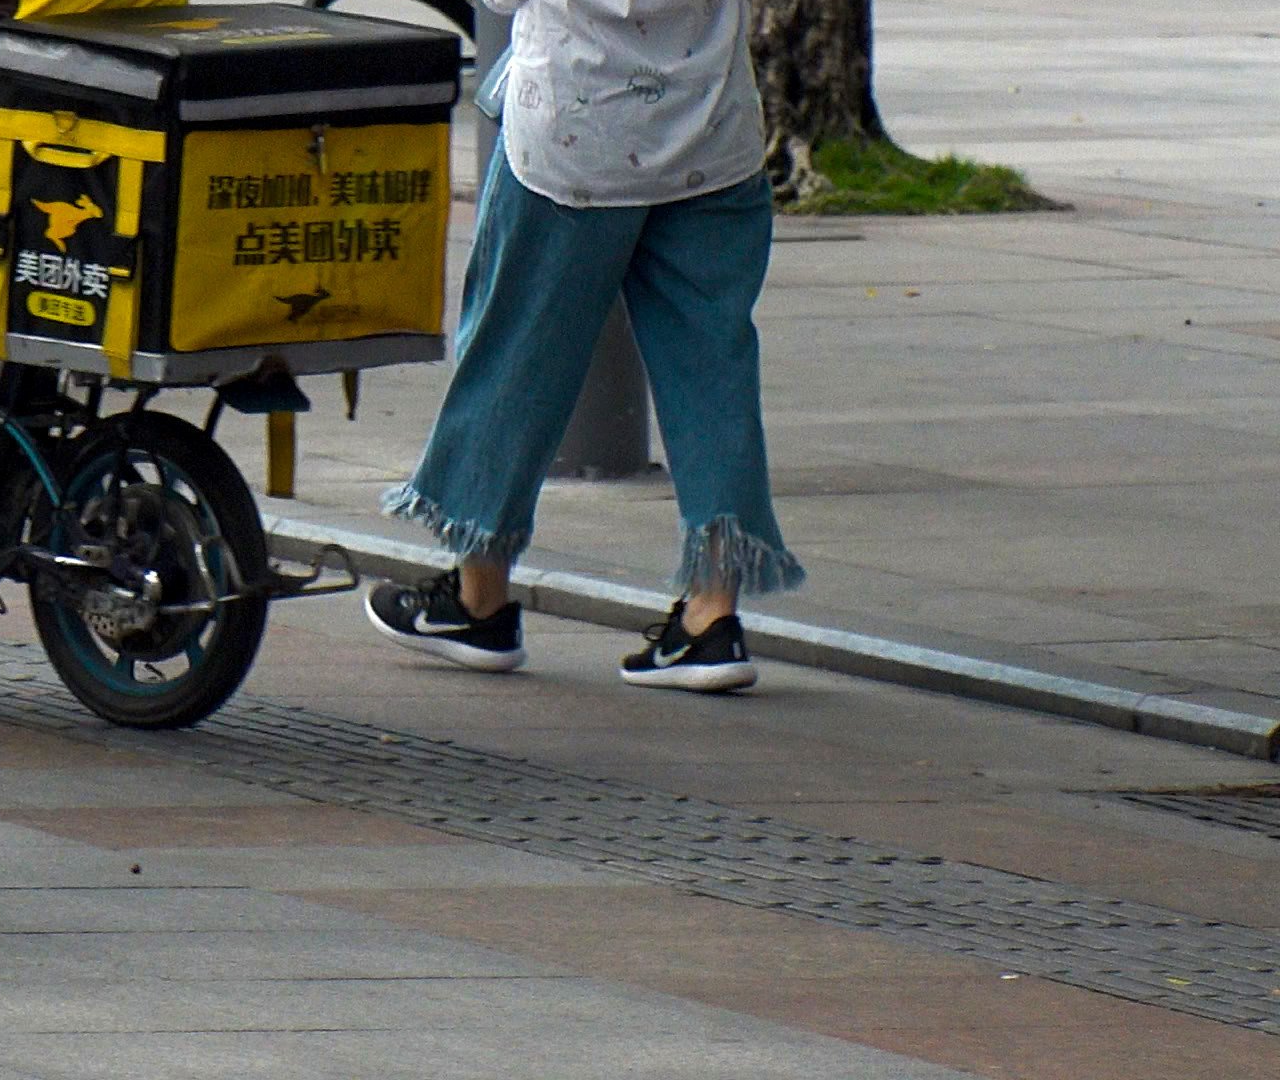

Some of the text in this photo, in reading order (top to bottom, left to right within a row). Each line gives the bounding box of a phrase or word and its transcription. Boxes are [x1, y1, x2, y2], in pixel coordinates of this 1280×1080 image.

[232, 219, 403, 266] 点美团外卖
[14, 249, 109, 298] 美团外卖
